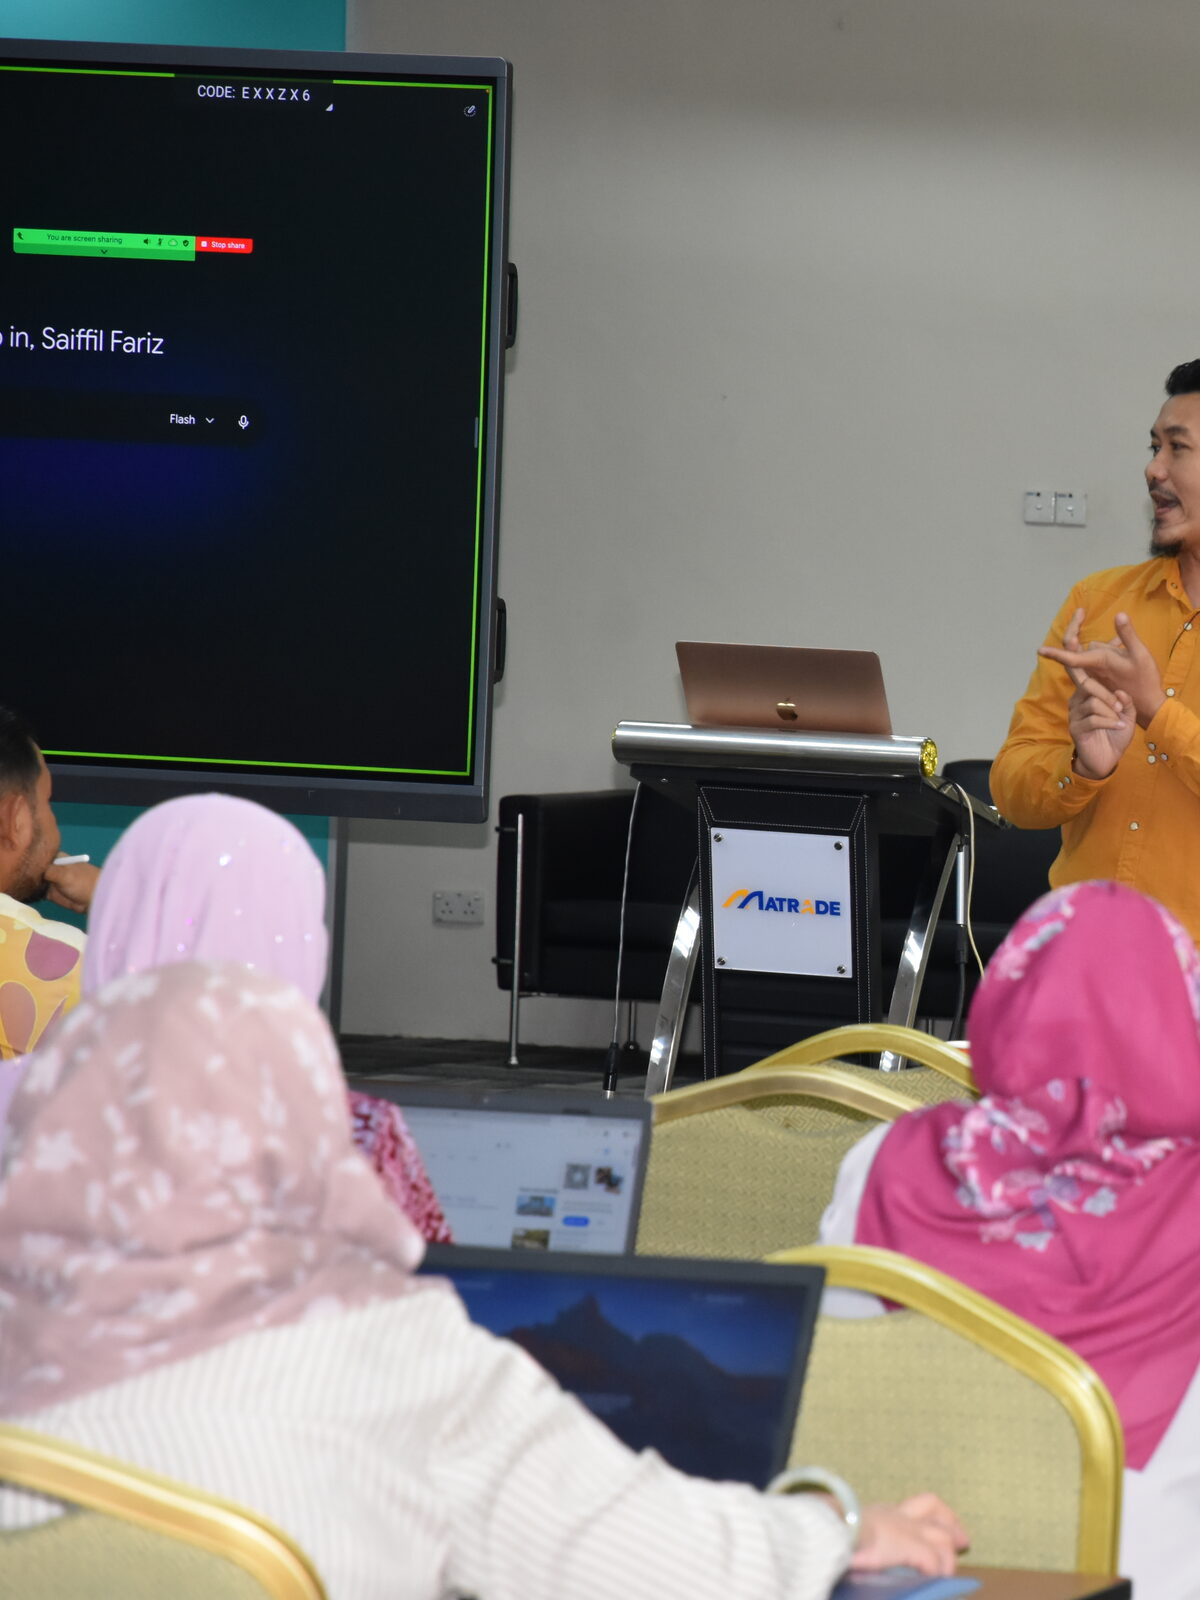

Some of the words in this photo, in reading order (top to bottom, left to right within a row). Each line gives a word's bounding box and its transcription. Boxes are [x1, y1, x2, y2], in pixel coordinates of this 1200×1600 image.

[197, 84, 236, 99] CODE:
[98, 236, 123, 244] sharing
[211, 241, 226, 249] Stop
[228, 241, 245, 249] share
[10, 325, 35, 350] in,
[41, 327, 103, 352] Saiffil
[110, 330, 164, 354] Fariz
[169, 413, 196, 425] Flash
[722, 888, 841, 916] MATRADE
